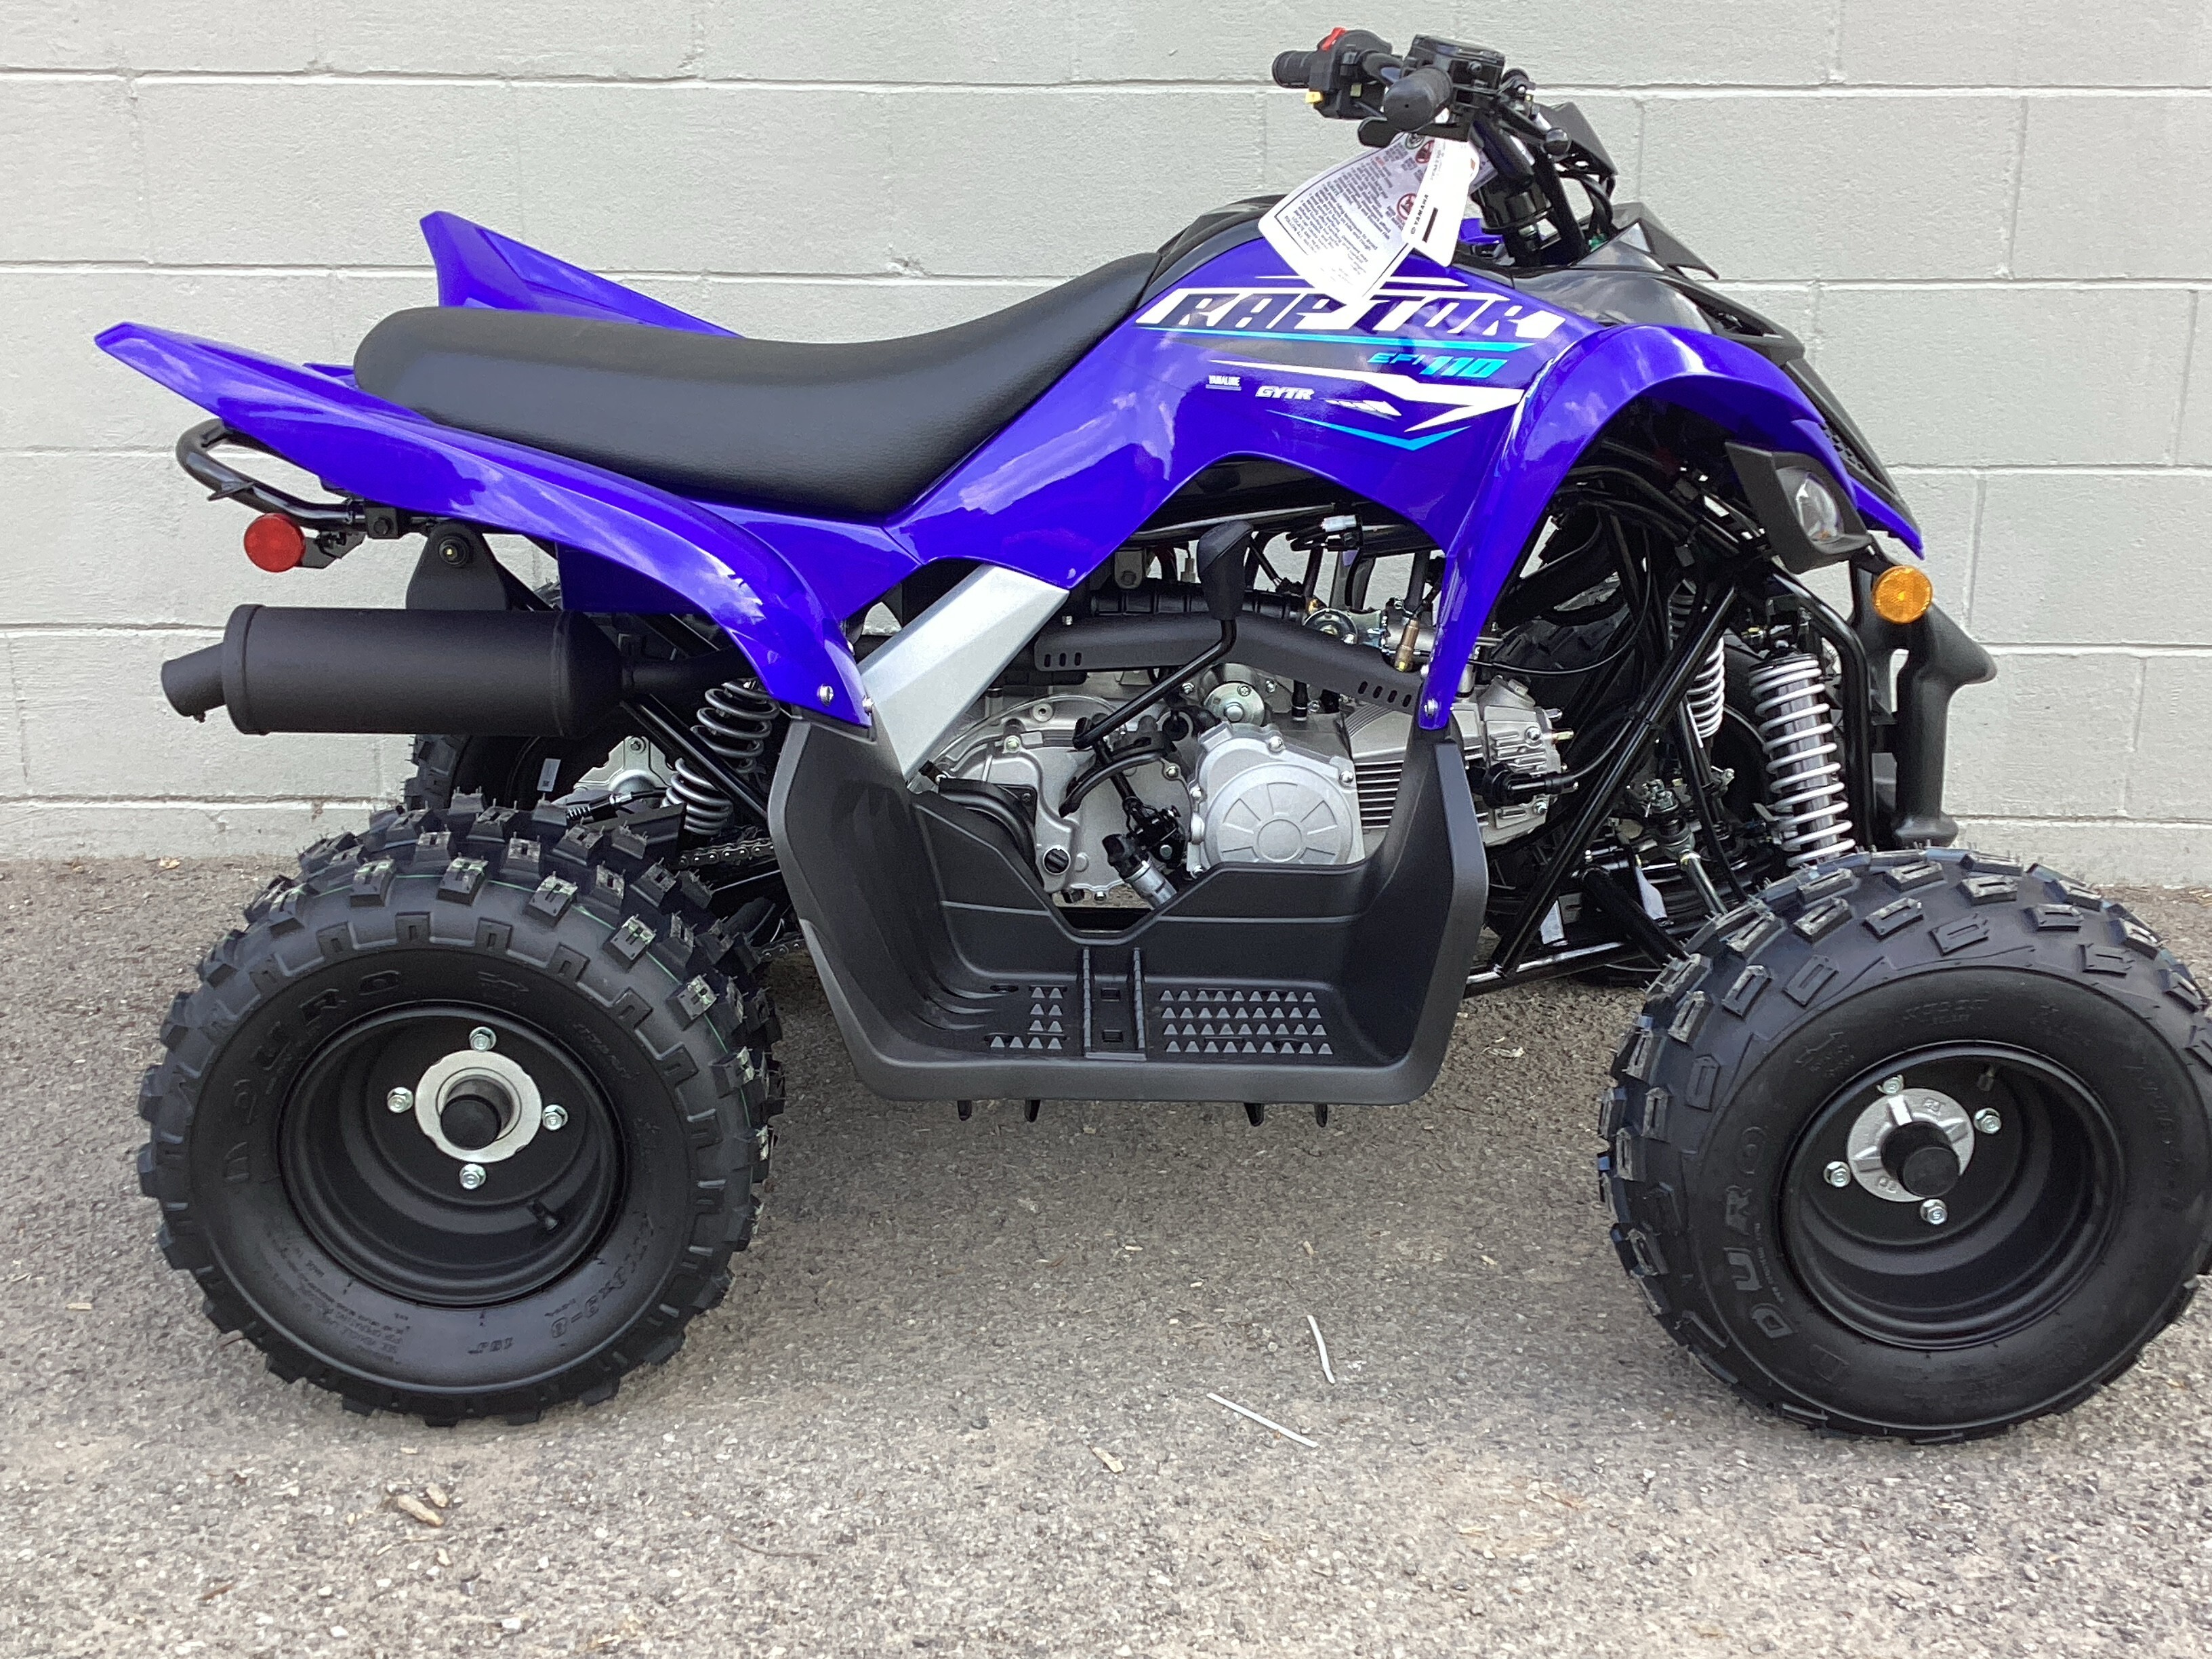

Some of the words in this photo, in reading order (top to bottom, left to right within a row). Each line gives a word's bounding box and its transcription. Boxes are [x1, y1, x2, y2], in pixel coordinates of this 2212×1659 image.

[1414, 194, 1429, 226] YAMAHA
[1145, 290, 1559, 339] RAPTOR
[1419, 356, 1509, 379] 110
[1255, 385, 1315, 401] GYTR
[1723, 1125, 1797, 1340] DURO
